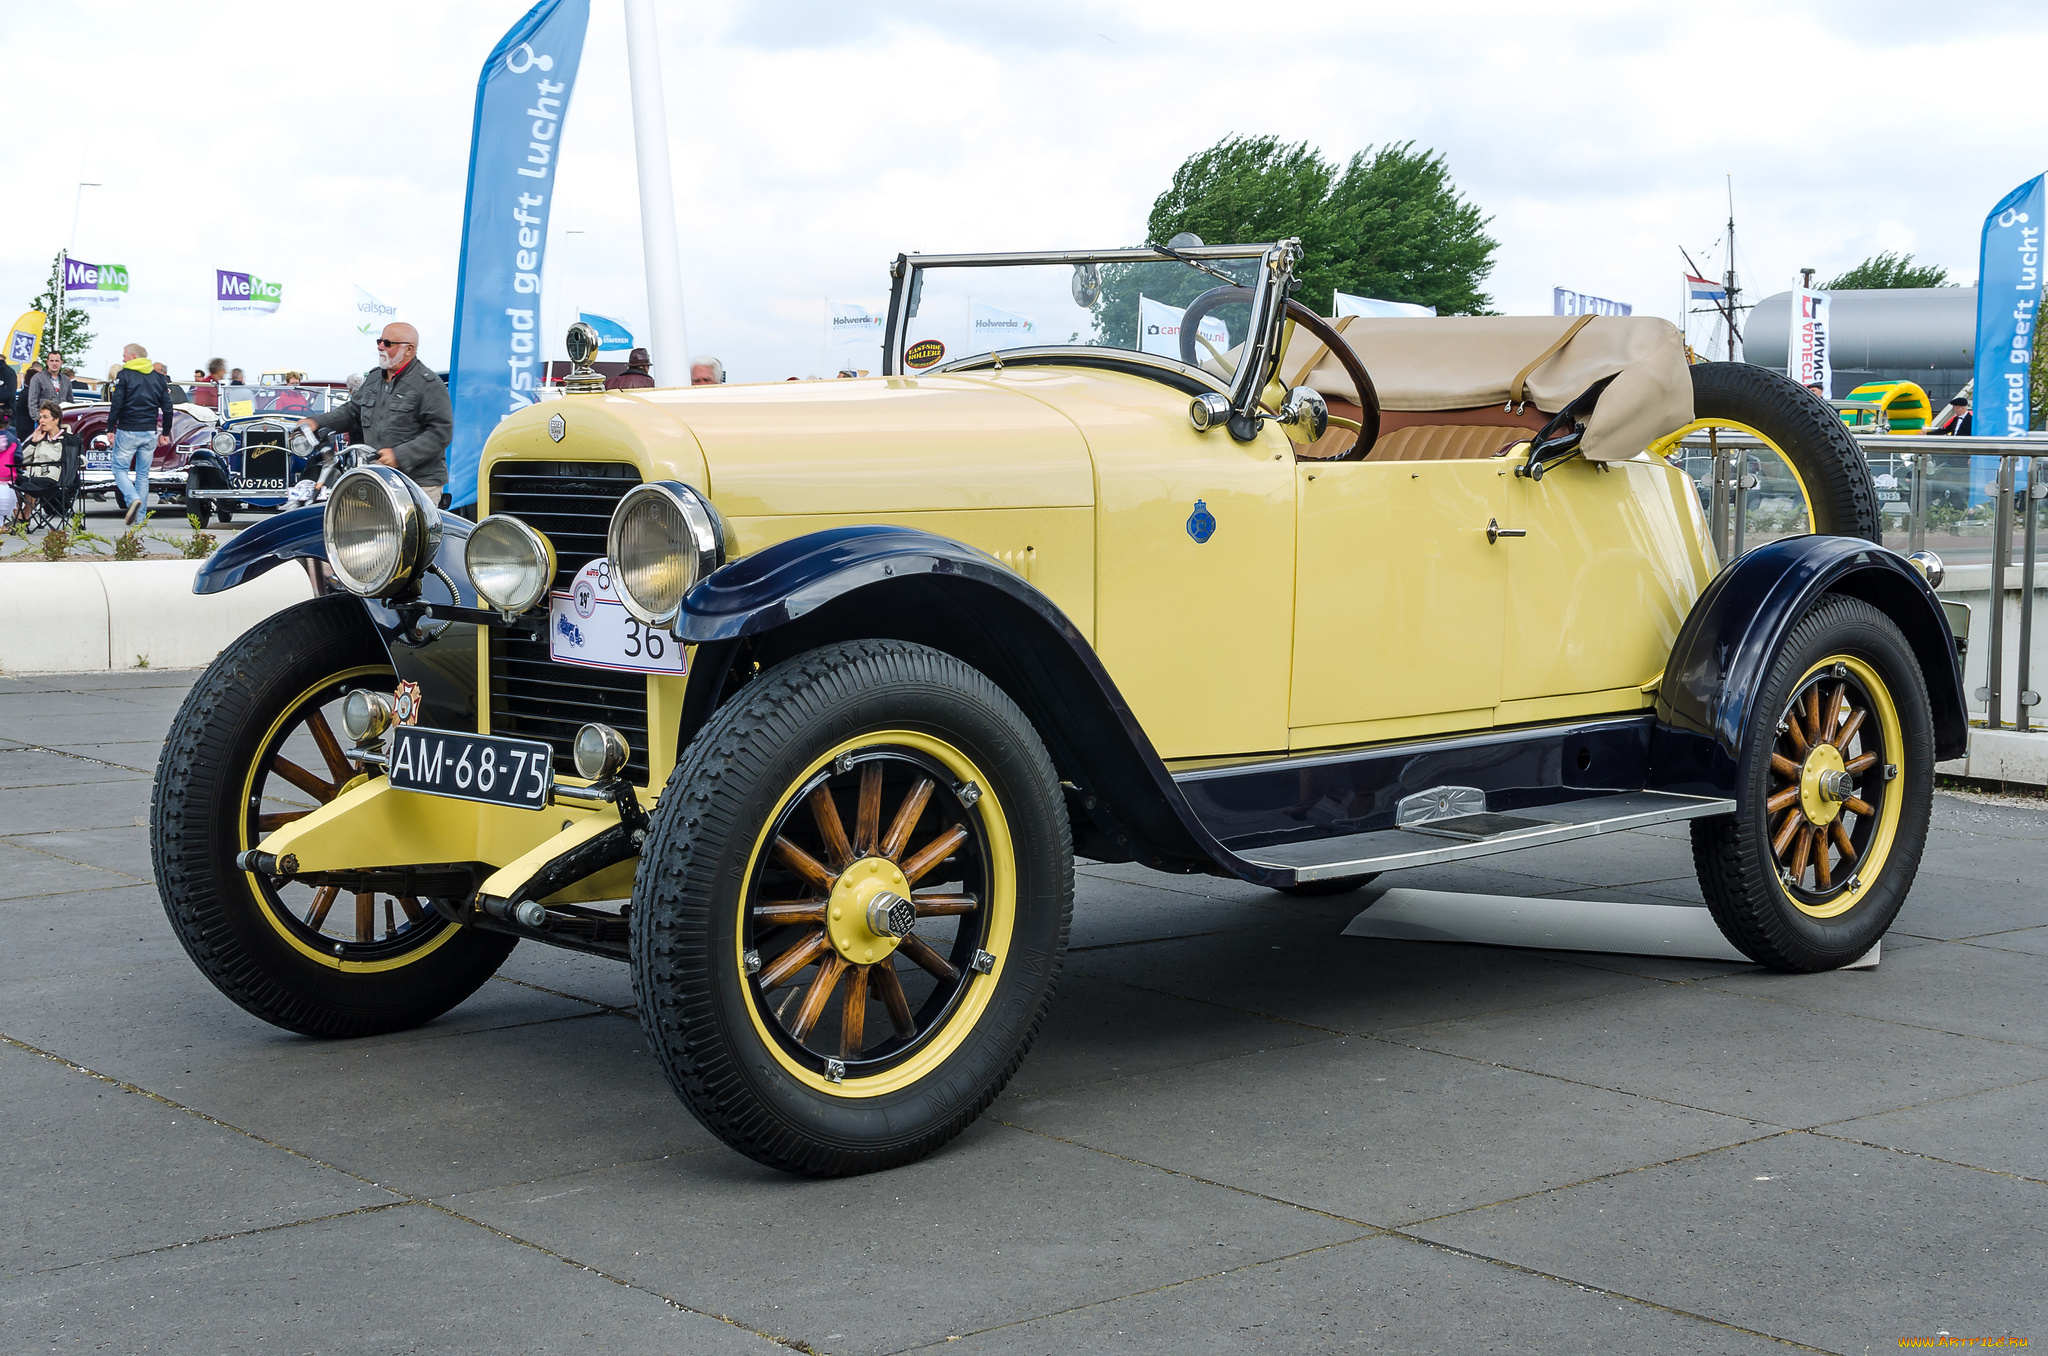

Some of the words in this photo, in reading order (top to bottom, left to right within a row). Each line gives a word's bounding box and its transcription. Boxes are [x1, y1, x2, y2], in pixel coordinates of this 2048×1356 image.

[517, 78, 565, 179] lucht
[513, 192, 544, 294] geeft
[2016, 226, 2039, 291] lucht
[67, 263, 128, 286] MeMo
[357, 300, 398, 316] valspar
[833, 314, 872, 326] Holwerda
[975, 318, 1018, 328] Holwerda
[2009, 299, 2034, 364] geeft
[88, 452, 113, 461] AR-19-4
[624, 616, 665, 660] 36
[391, 736, 546, 799] AM-68-75
[728, 704, 860, 880] MICHELIN
[897, 900, 914, 929] ESSEX
[923, 946, 1048, 1118] MICHELIN
